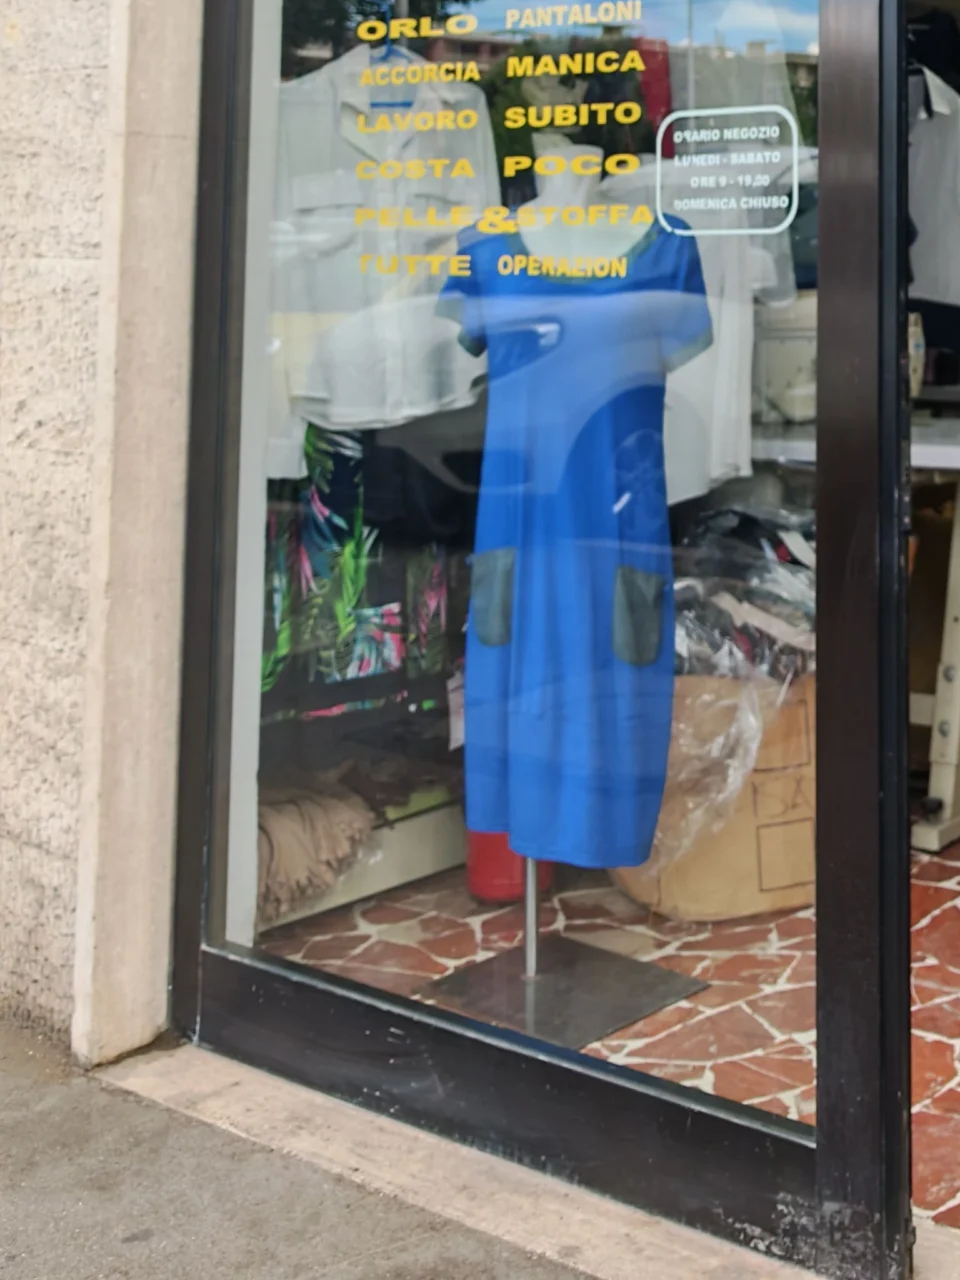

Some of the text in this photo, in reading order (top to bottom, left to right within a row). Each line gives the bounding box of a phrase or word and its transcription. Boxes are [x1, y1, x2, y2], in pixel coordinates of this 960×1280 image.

[356, 0, 642, 41] ORLO PANTALONI
[360, 50, 646, 86] ACCORCIA MANICA
[356, 102, 642, 134] LAVORO SUBITO
[673, 125, 780, 143] ORARIO NEGOZIO
[355, 153, 641, 180] COSTA POCO
[730, 151, 781, 165] SABATO
[690, 175, 716, 188] ORE
[674, 195, 789, 211] DOMENICA CHIUSO
[358, 255, 472, 277] TUTTE
